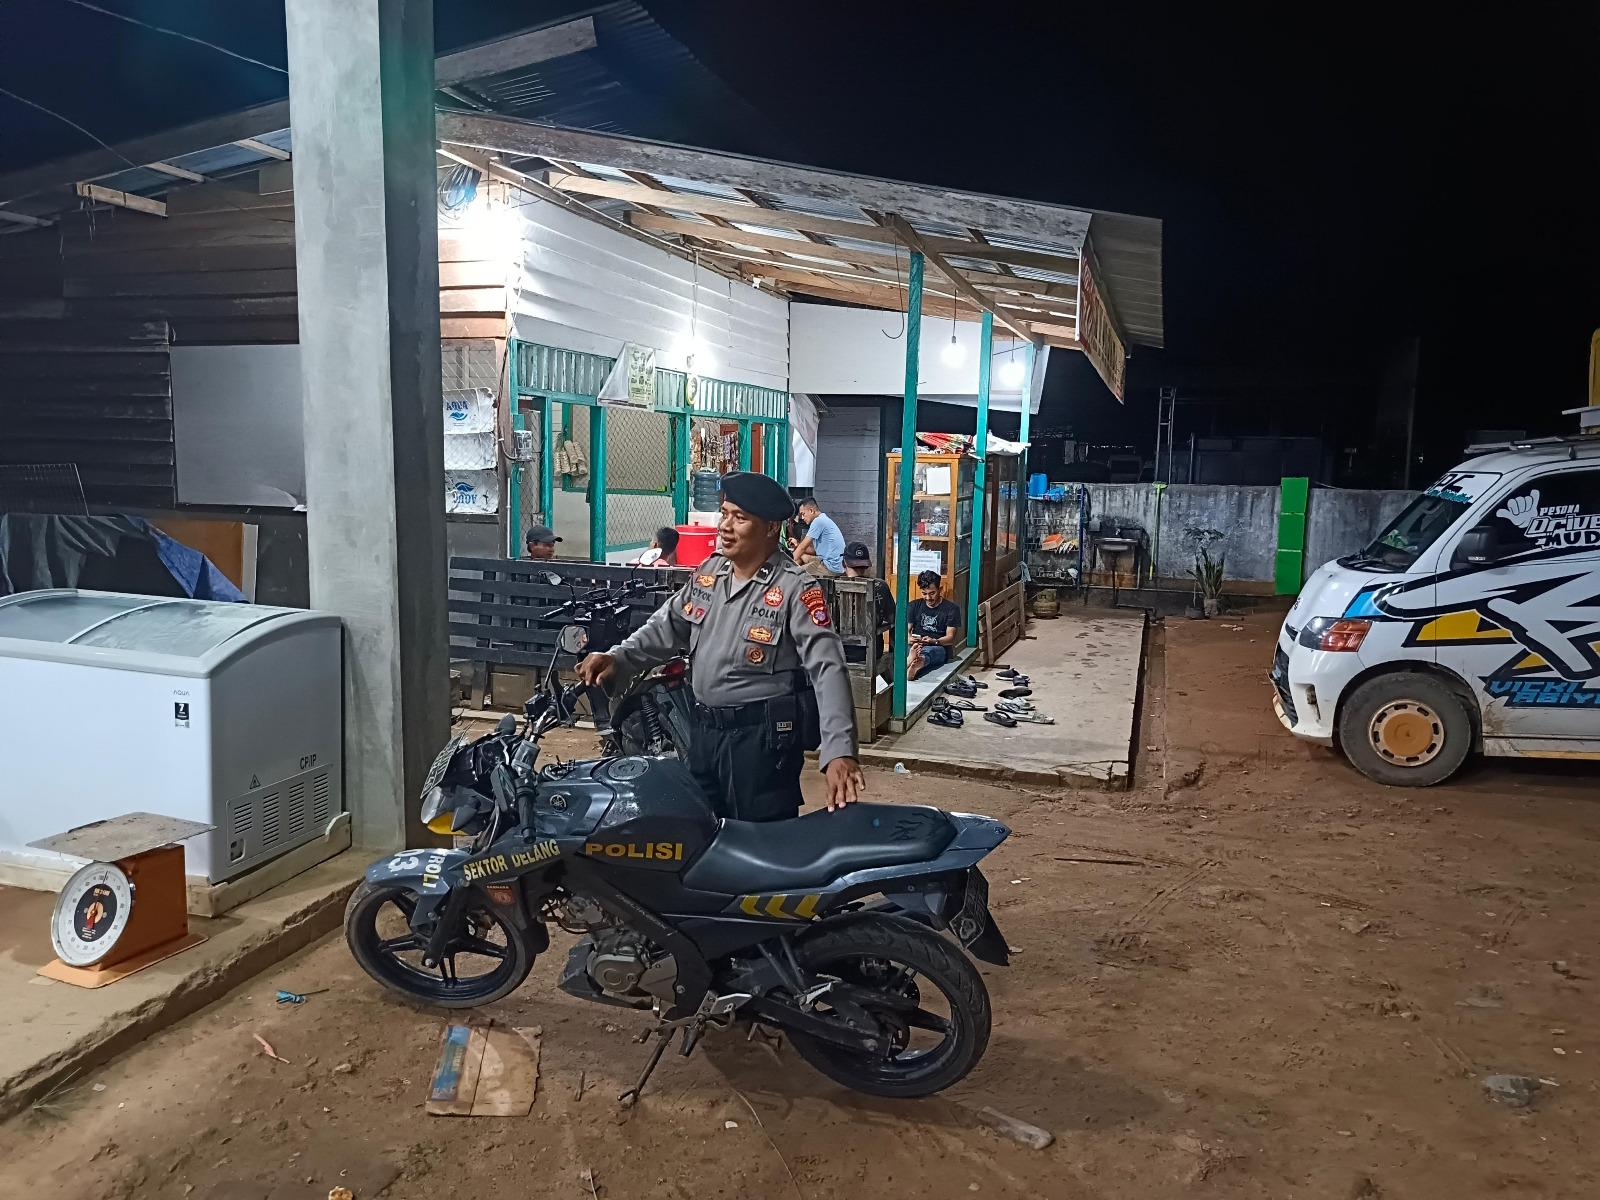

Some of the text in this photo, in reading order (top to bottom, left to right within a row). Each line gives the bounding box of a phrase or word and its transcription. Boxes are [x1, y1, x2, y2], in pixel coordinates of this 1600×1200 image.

[446, 401, 468, 411] AQUA
[751, 606, 779, 620] POLRI
[1490, 681, 1579, 693] VICKI
[179, 703, 185, 712] 7
[585, 842, 683, 860] POLISI
[463, 838, 560, 881] SEKTOR DELANG
